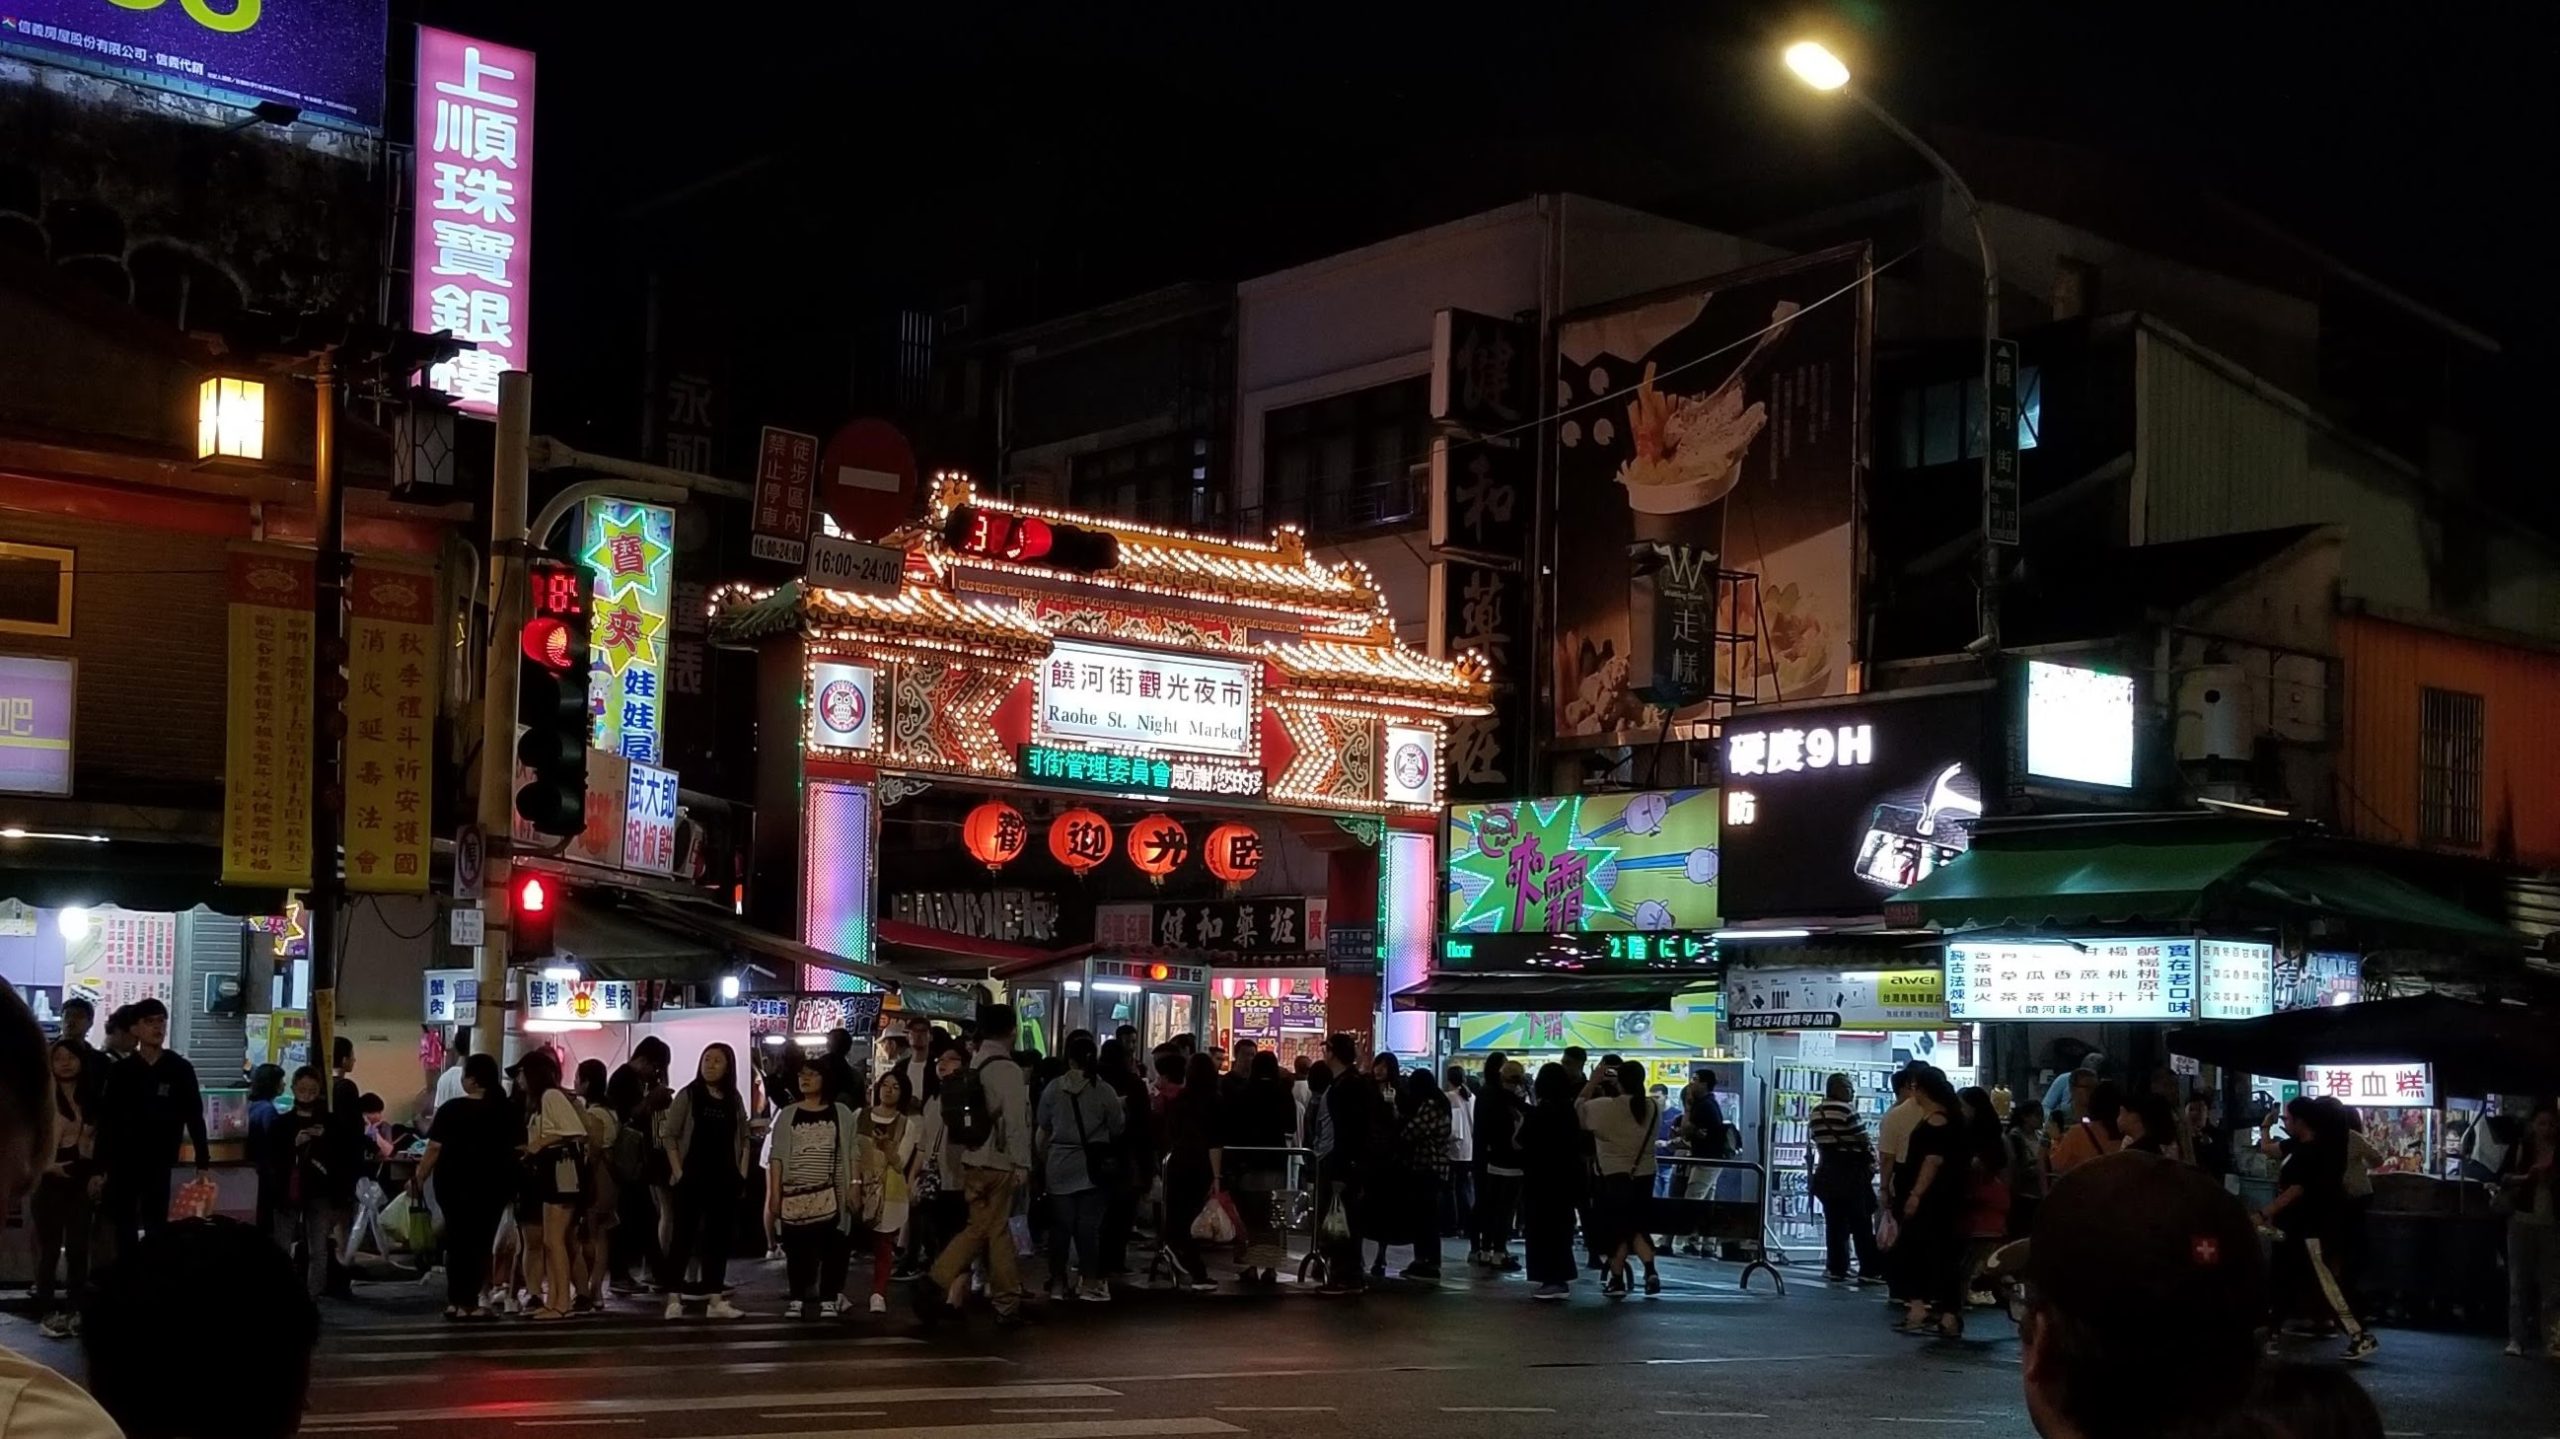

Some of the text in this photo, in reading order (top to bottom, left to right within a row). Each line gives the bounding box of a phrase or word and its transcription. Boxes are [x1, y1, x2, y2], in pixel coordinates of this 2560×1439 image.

[762, 434, 788, 529] 禁止停車
[785, 439, 813, 534] 徒步區內
[815, 549, 899, 584] 16:00~24:00
[1671, 609, 1701, 684] 走樣
[1051, 659, 1243, 708] 饒河街觀光夜市
[1049, 704, 1243, 742] Raohe St. Night Market
[1728, 724, 1873, 777] 硬度9H
[629, 768, 676, 820] 武大郎
[1727, 791, 1756, 826] 防
[626, 816, 673, 870] 胡椒餅
[2108, 946, 2128, 1001] 楊桃汁
[2167, 944, 2192, 1014] 實在老口味
